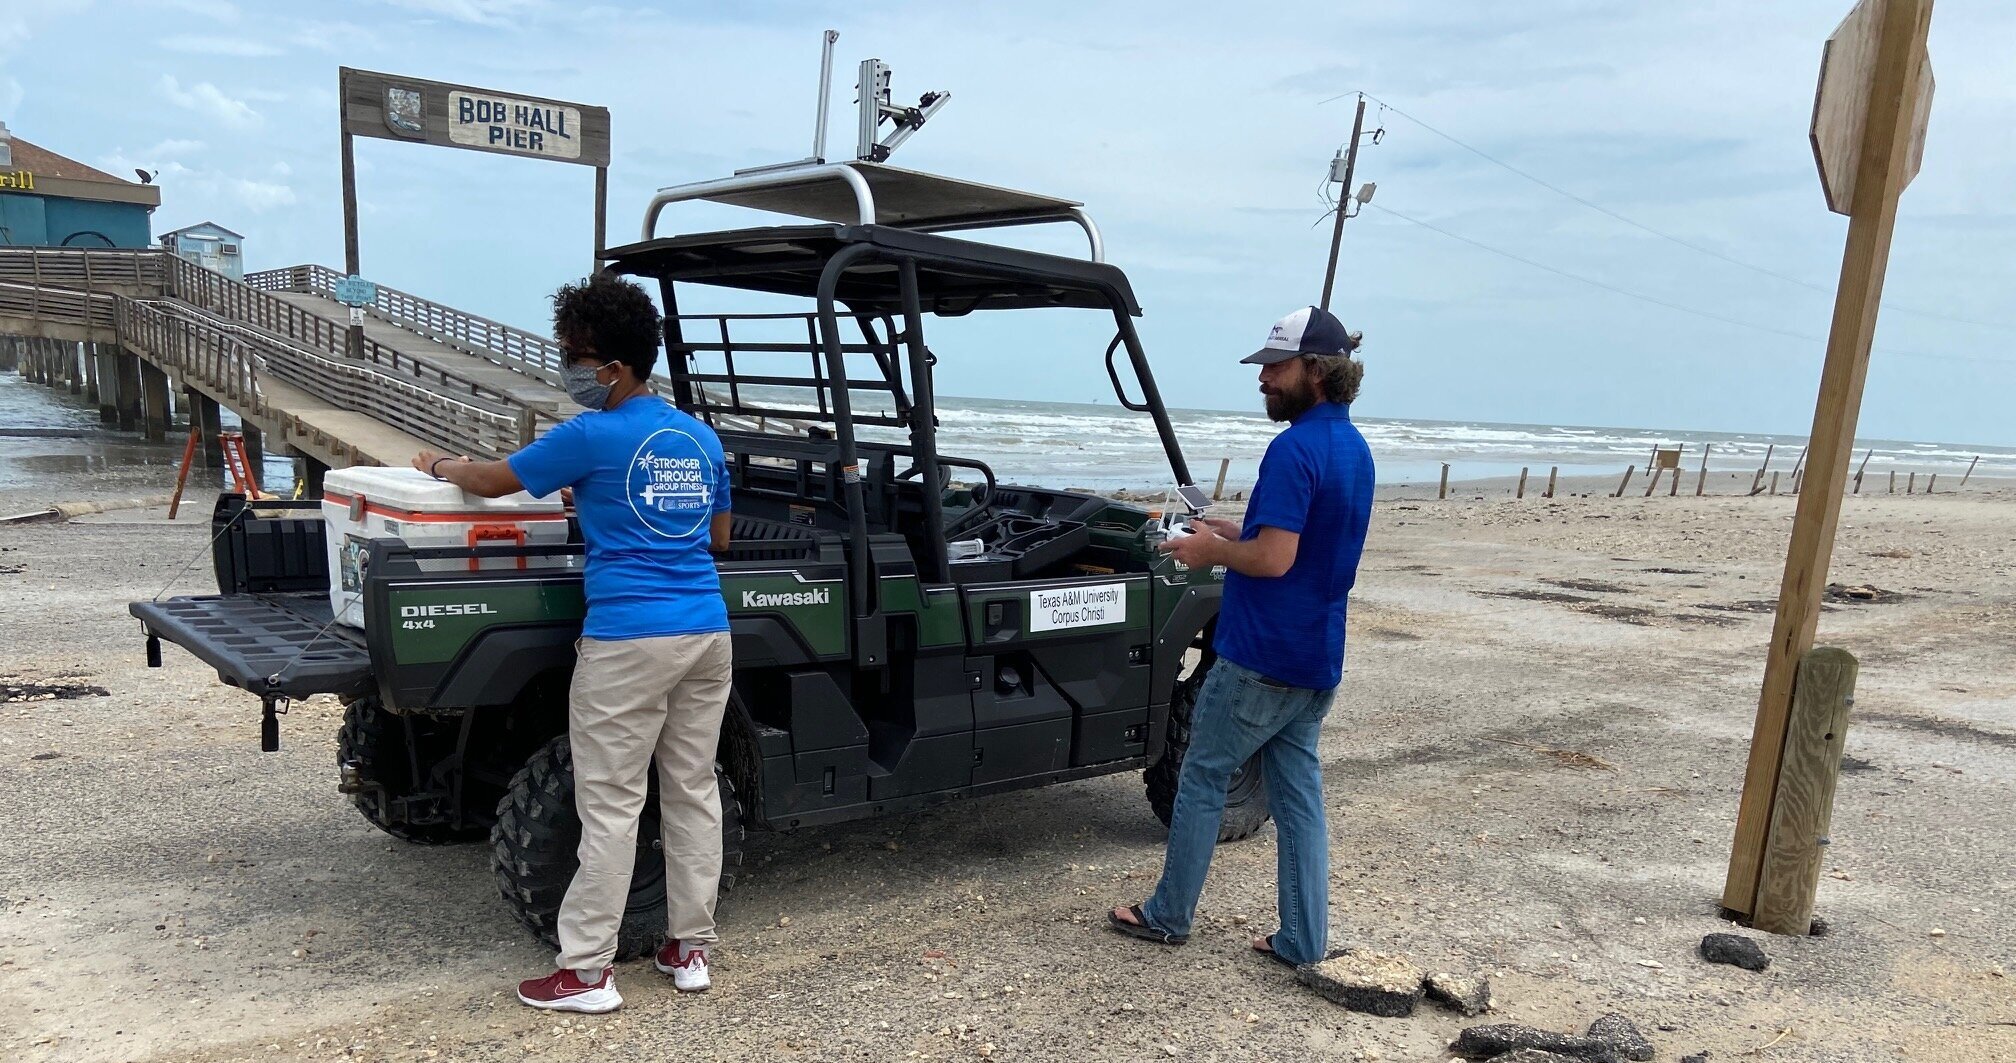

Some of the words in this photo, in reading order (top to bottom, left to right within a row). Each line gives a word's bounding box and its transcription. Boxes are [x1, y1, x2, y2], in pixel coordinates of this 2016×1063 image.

[459, 96, 507, 125] BOB
[515, 105, 570, 139] HALL
[489, 125, 543, 151] PIER
[653, 458, 701, 469] STRONGER
[653, 470, 702, 482] THROUGH
[652, 482, 679, 491] GROUP
[680, 483, 703, 491] FITNESS
[742, 587, 829, 608] Kawasaki
[1038, 594, 1061, 609] Texas
[1062, 590, 1080, 606] A&M
[1083, 588, 1119, 605] University
[401, 603, 498, 617] DIESEL
[1052, 609, 1080, 627] Corpus
[1081, 606, 1105, 622] Christi
[402, 619, 436, 630] 4x4
